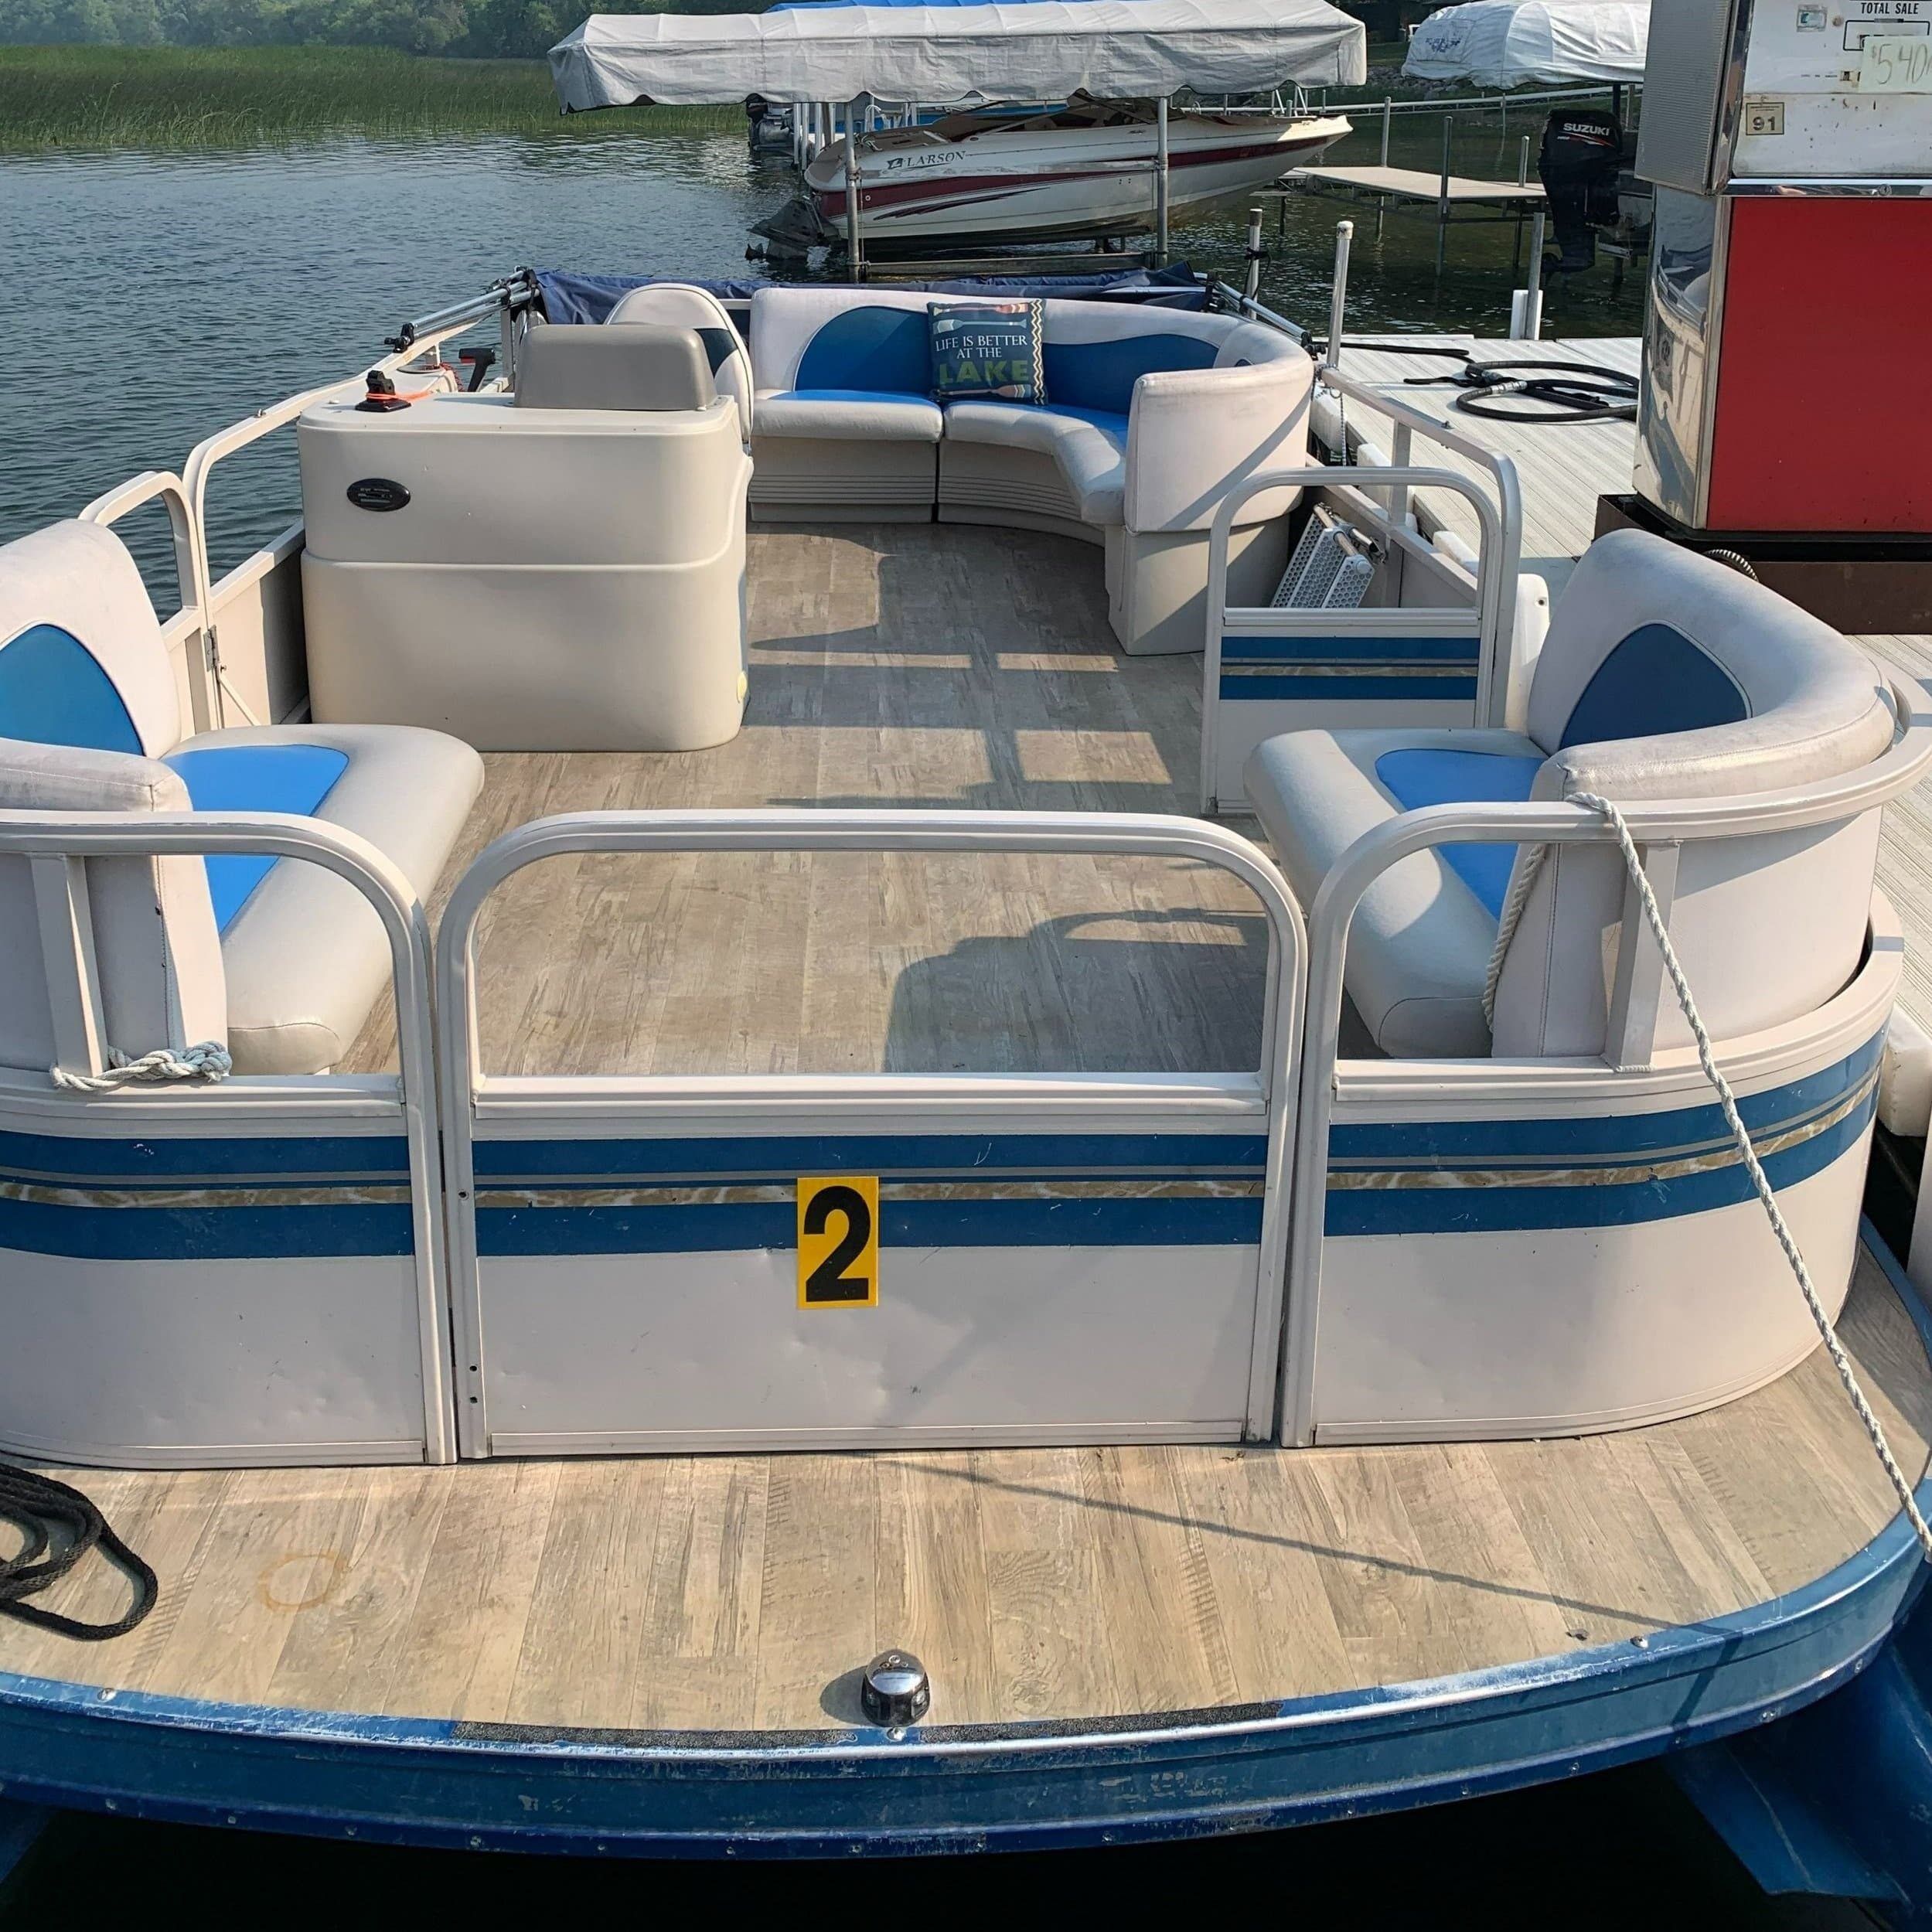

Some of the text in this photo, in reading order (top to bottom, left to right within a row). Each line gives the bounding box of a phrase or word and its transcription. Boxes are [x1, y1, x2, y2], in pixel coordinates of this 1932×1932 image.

[1861, 2, 1919, 15] TOTAL SALE
[1562, 123, 1610, 136] SUZUKI
[1753, 116, 1775, 131] 91
[907, 151, 966, 167] LARSON
[935, 335, 1027, 352] LIFE IS BETTER
[956, 346, 1002, 359] AT THE
[939, 359, 1029, 385] LAKE
[803, 1185, 871, 1302] 2
